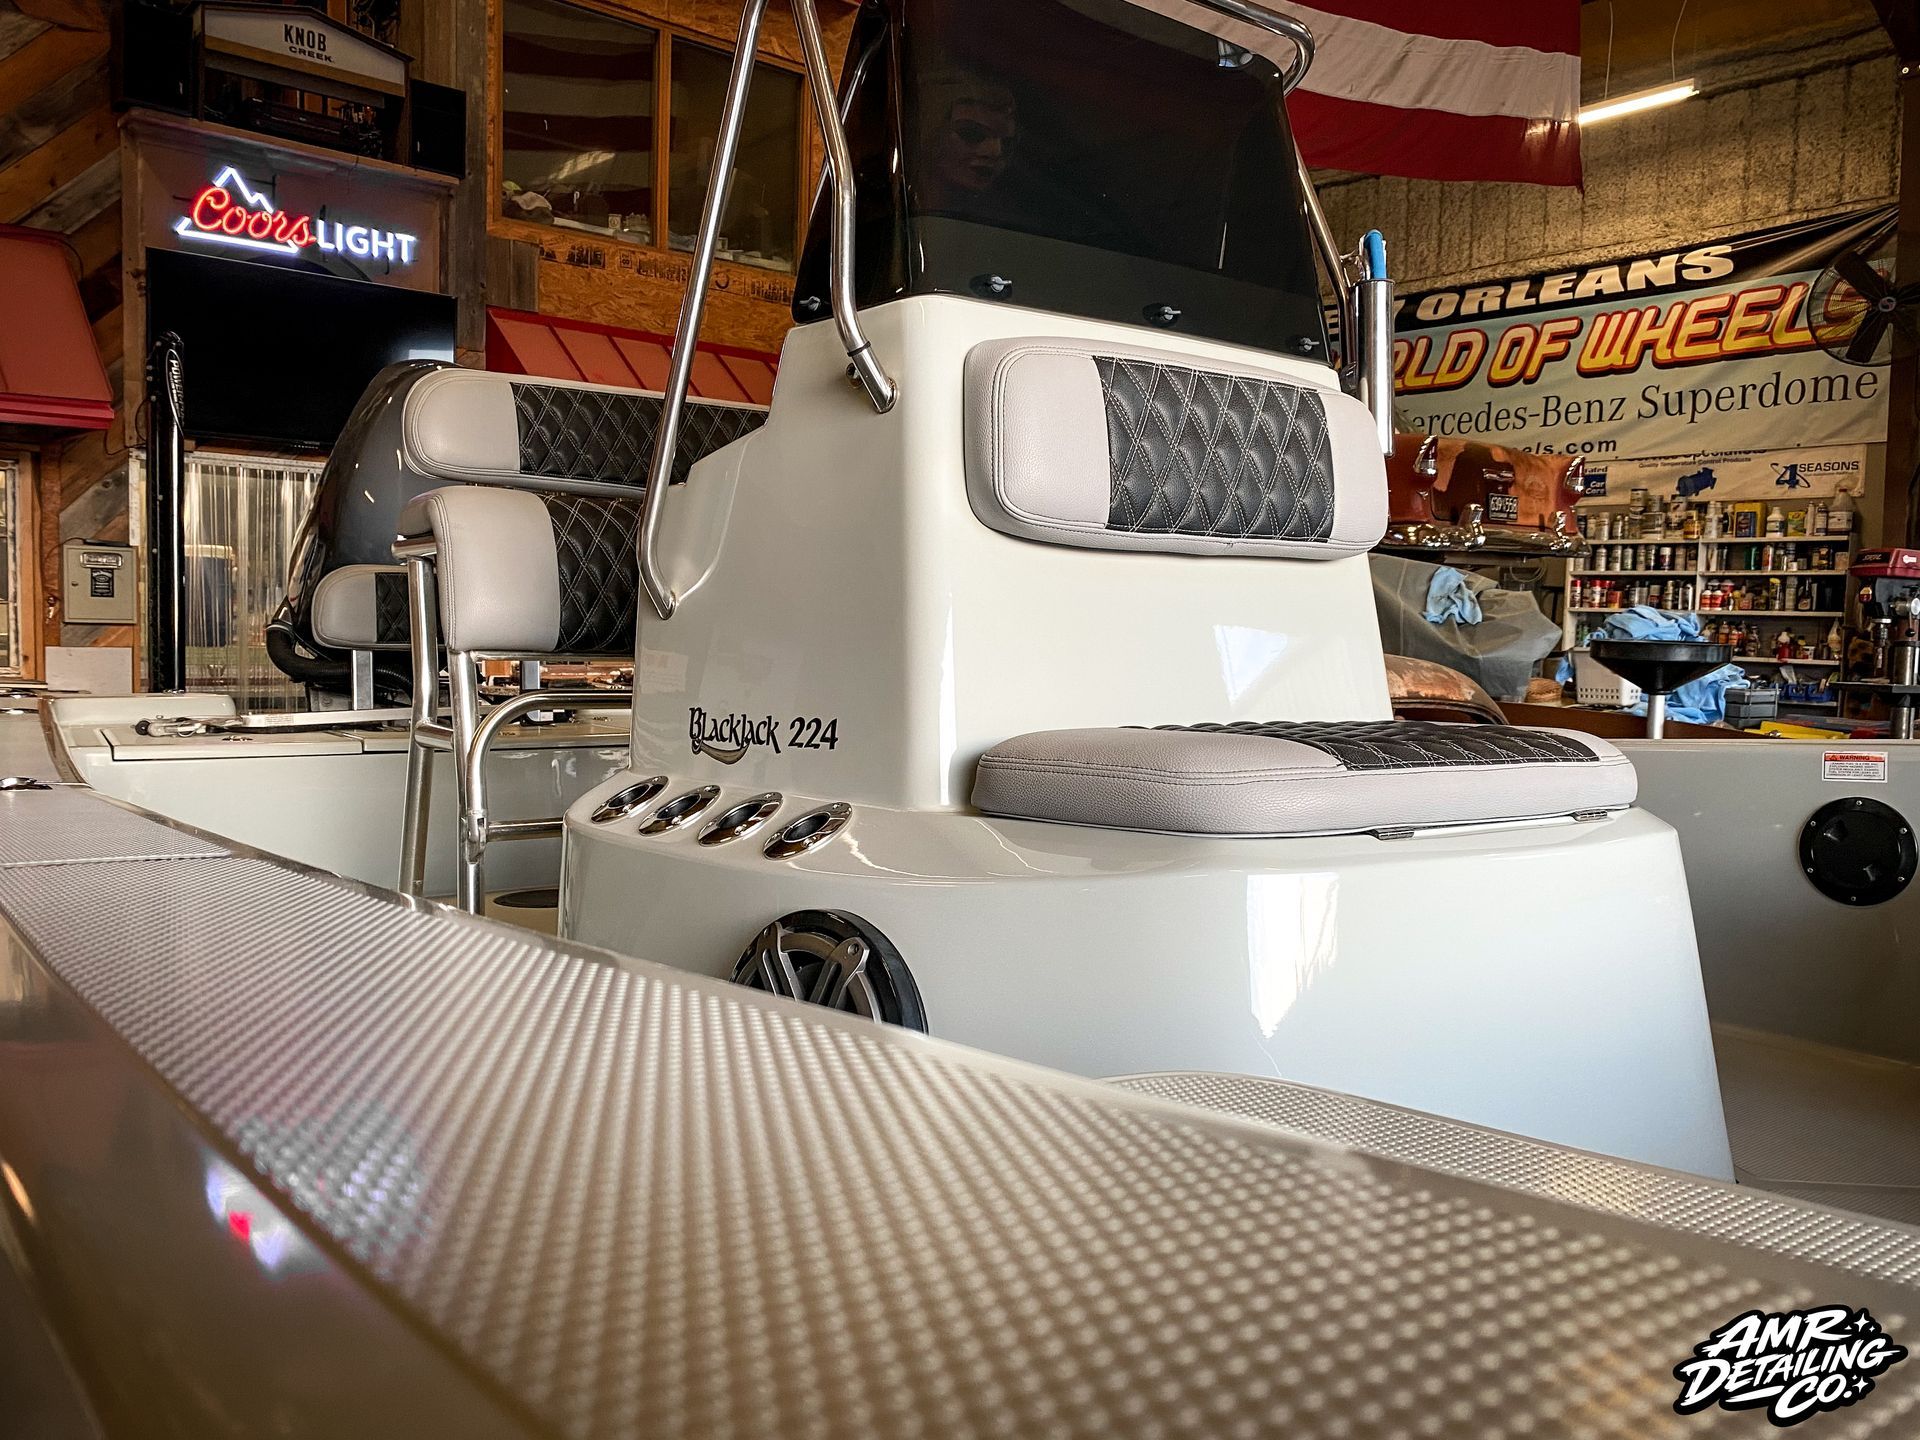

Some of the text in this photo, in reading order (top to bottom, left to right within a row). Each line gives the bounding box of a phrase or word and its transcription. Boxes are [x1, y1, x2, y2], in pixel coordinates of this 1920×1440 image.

[284, 24, 327, 52] KNOB
[289, 46, 334, 63] CREEK
[192, 186, 417, 264] Coors LIGHT
[1416, 245, 1734, 321] ORLEANS
[1487, 316, 1583, 388] OF
[1403, 371, 1878, 436] ercedes-Benz Superdome
[1799, 461, 1860, 473] SEASONS
[788, 717, 838, 750] 224
